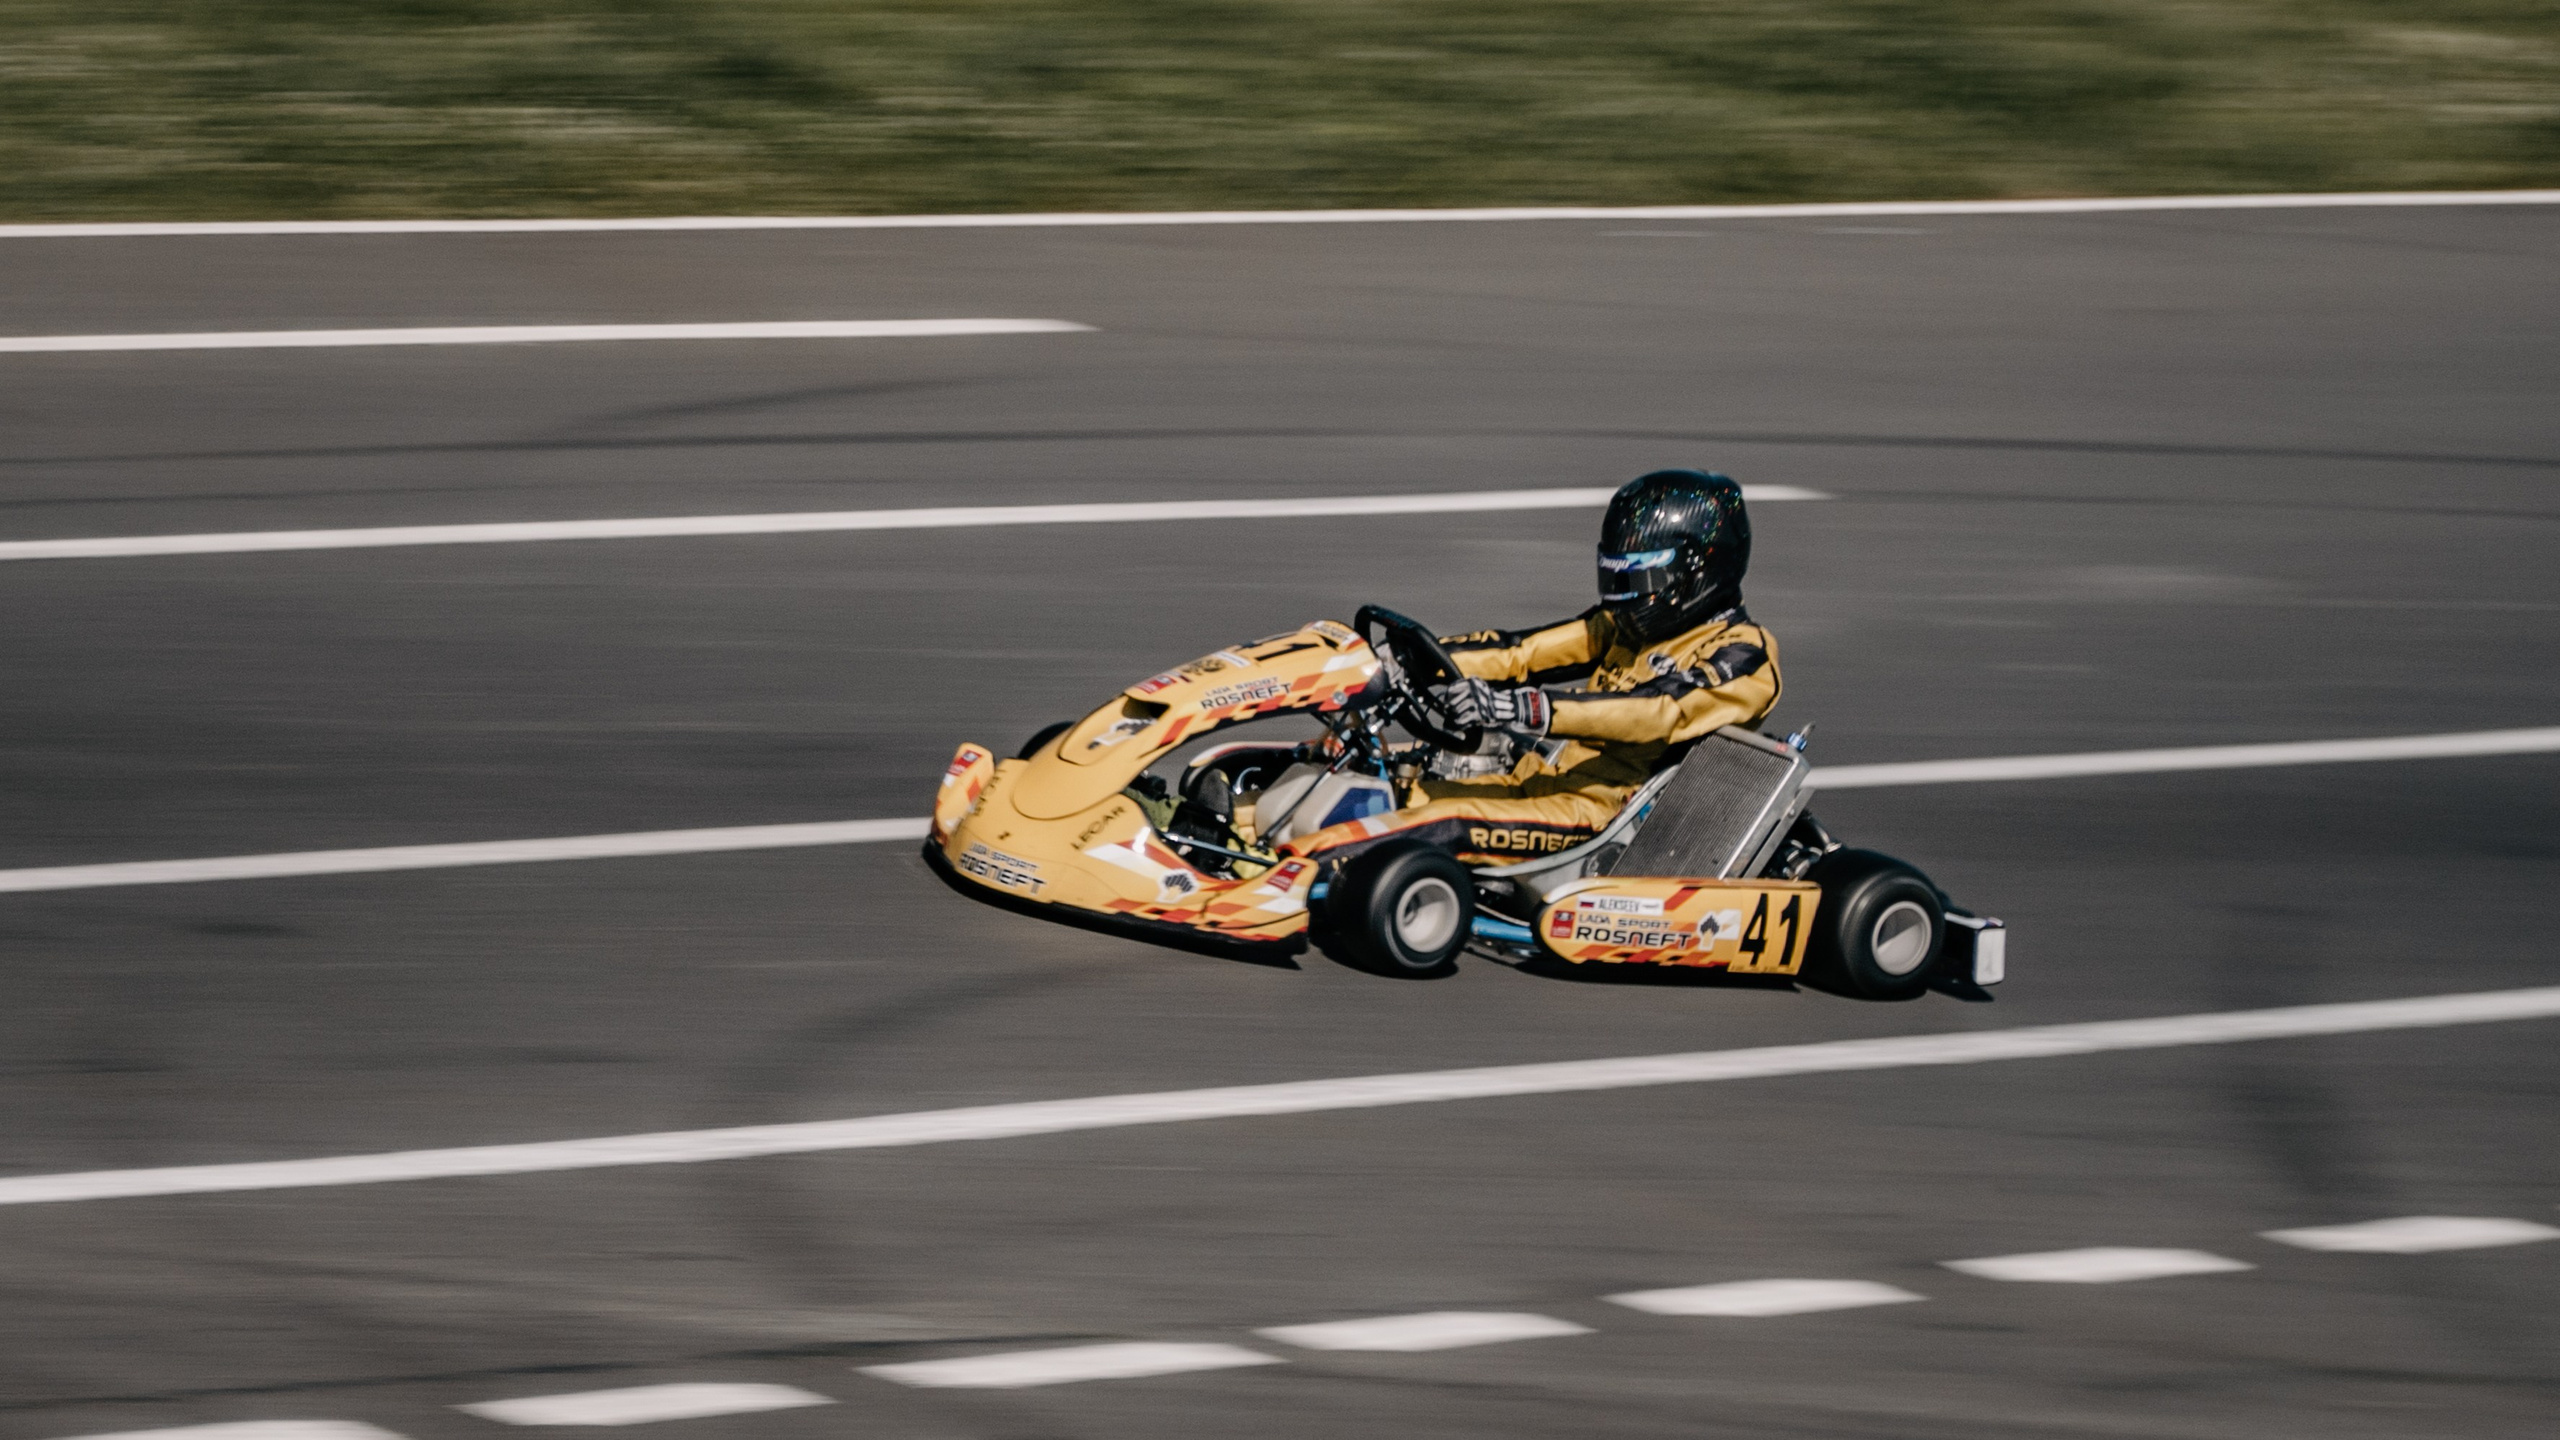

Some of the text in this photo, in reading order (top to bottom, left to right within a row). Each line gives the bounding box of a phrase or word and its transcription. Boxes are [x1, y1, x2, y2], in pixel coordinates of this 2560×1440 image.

[1201, 683, 1292, 710] ROSNEFT
[1206, 676, 1279, 697] LADA SPORT
[1579, 914, 1672, 929] LADA SPORT
[1739, 893, 1800, 966] 41
[1575, 926, 1693, 948] ROSNEFT
